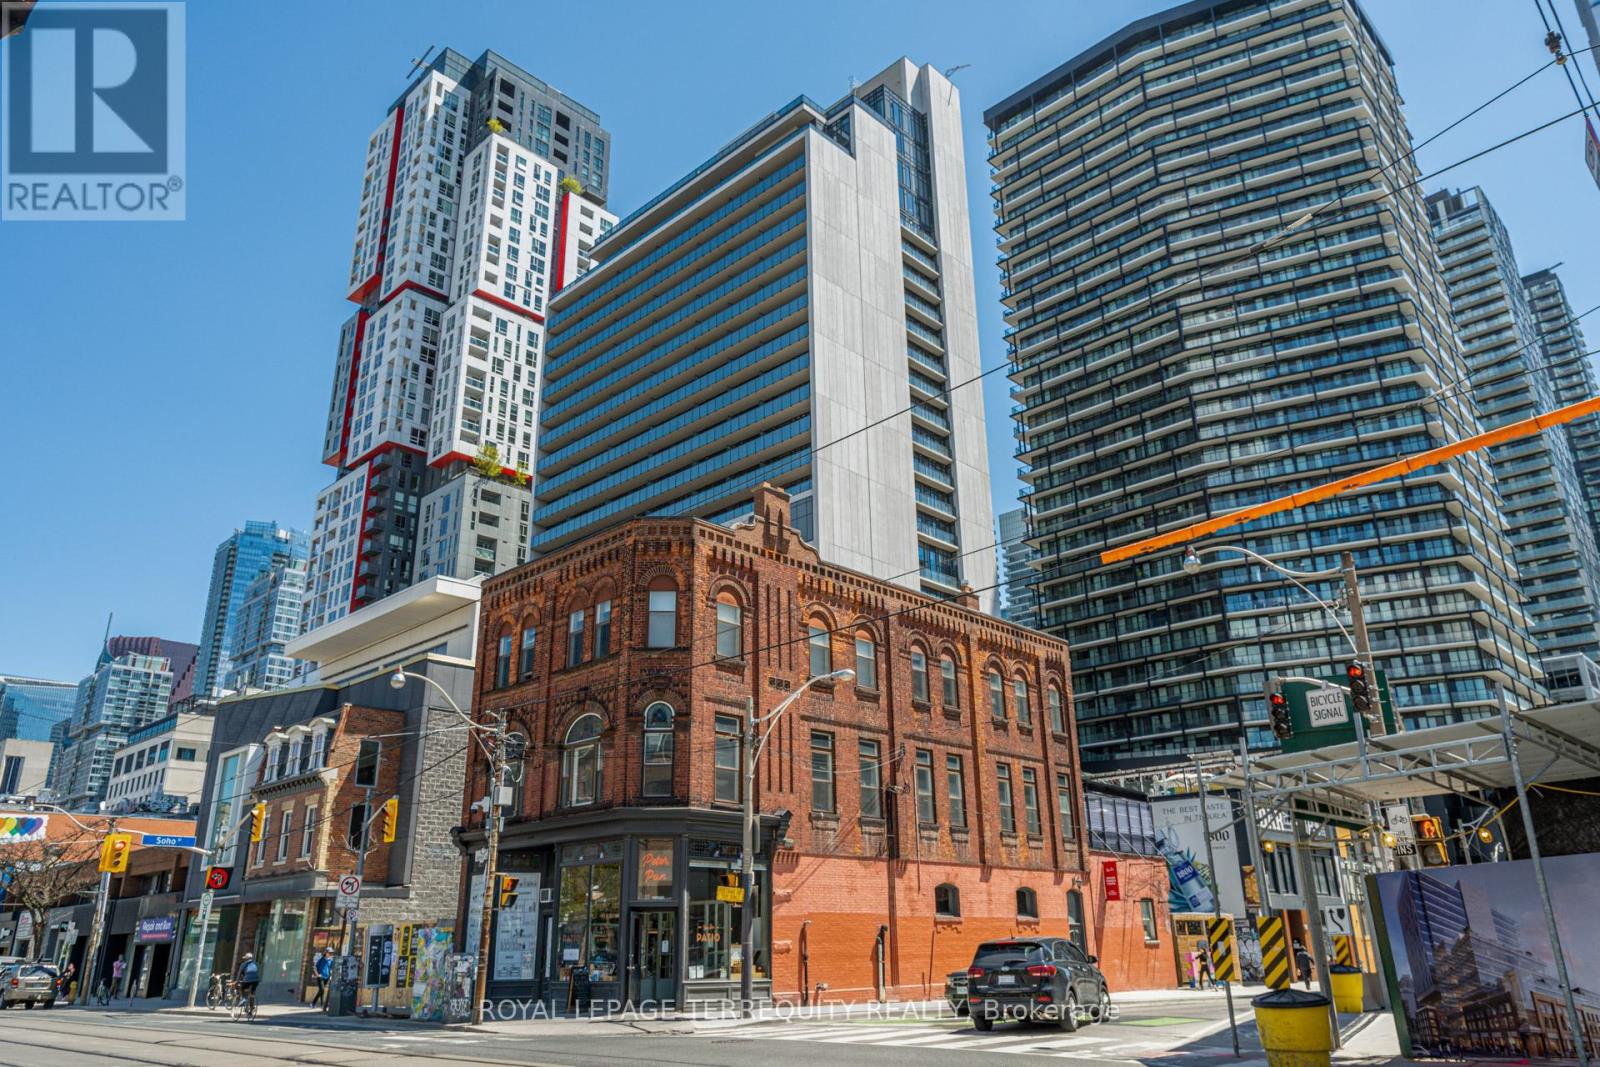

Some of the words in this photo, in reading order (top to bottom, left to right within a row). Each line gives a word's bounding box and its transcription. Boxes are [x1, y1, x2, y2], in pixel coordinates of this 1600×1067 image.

[1310, 692, 1342, 707] BICYCLE
[1313, 707, 1344, 721] SIGNAL
[1162, 807, 1176, 815] THE
[1179, 805, 1198, 813] BEST
[1206, 802, 1227, 810] ASTE
[155, 836, 177, 845] Soho
[696, 933, 721, 943] PATIO
